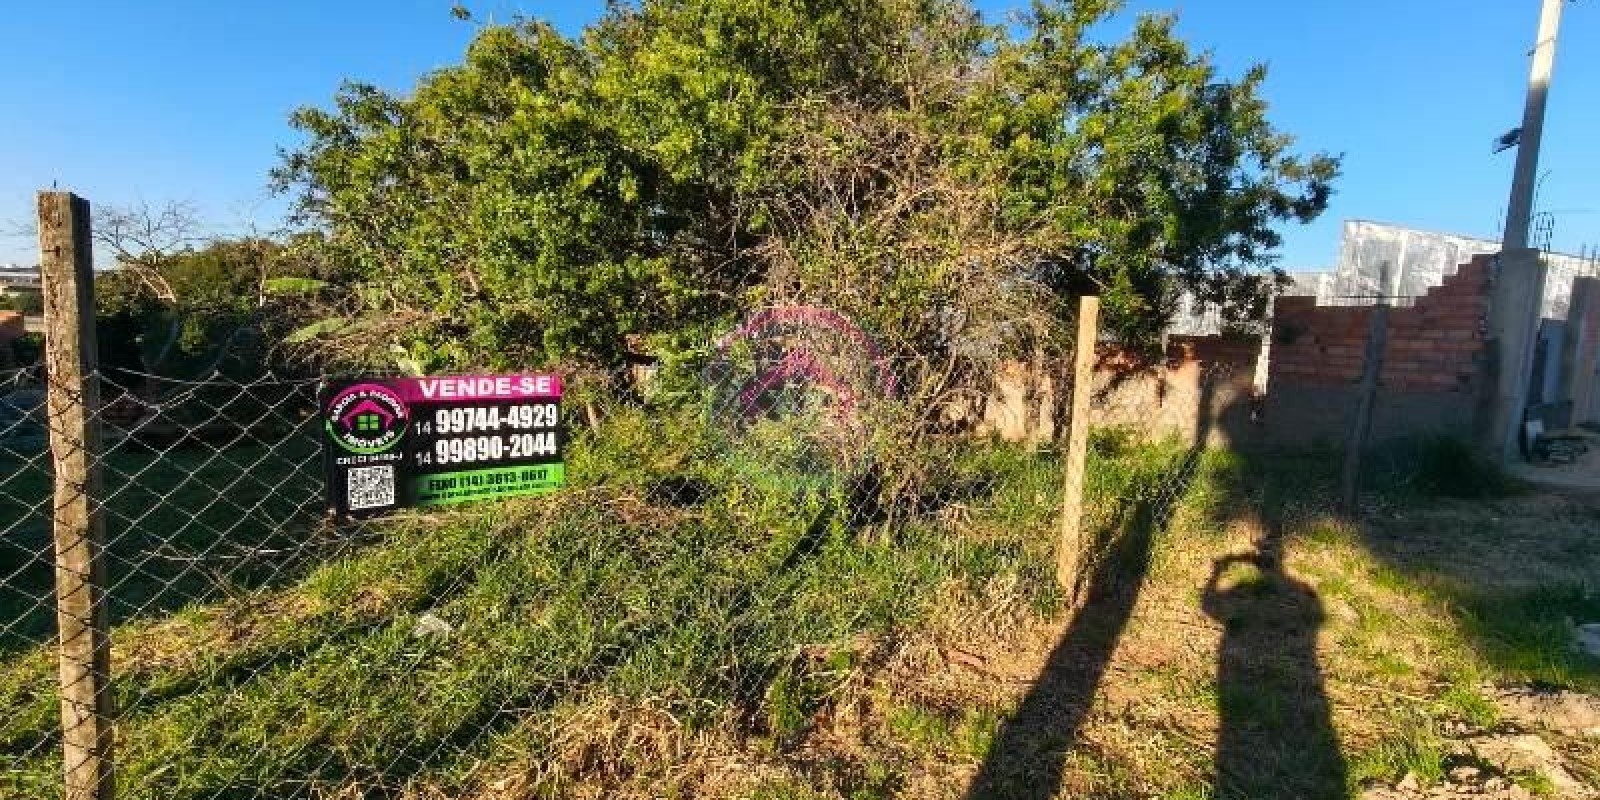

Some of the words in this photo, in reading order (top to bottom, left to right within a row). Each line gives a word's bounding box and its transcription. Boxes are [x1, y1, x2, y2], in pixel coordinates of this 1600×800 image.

[418, 377, 551, 398] VENDE-SE
[415, 421, 431, 436] 14
[435, 403, 557, 433] 99744-4929
[415, 451, 431, 467] 14
[435, 432, 557, 464] 99890-2044
